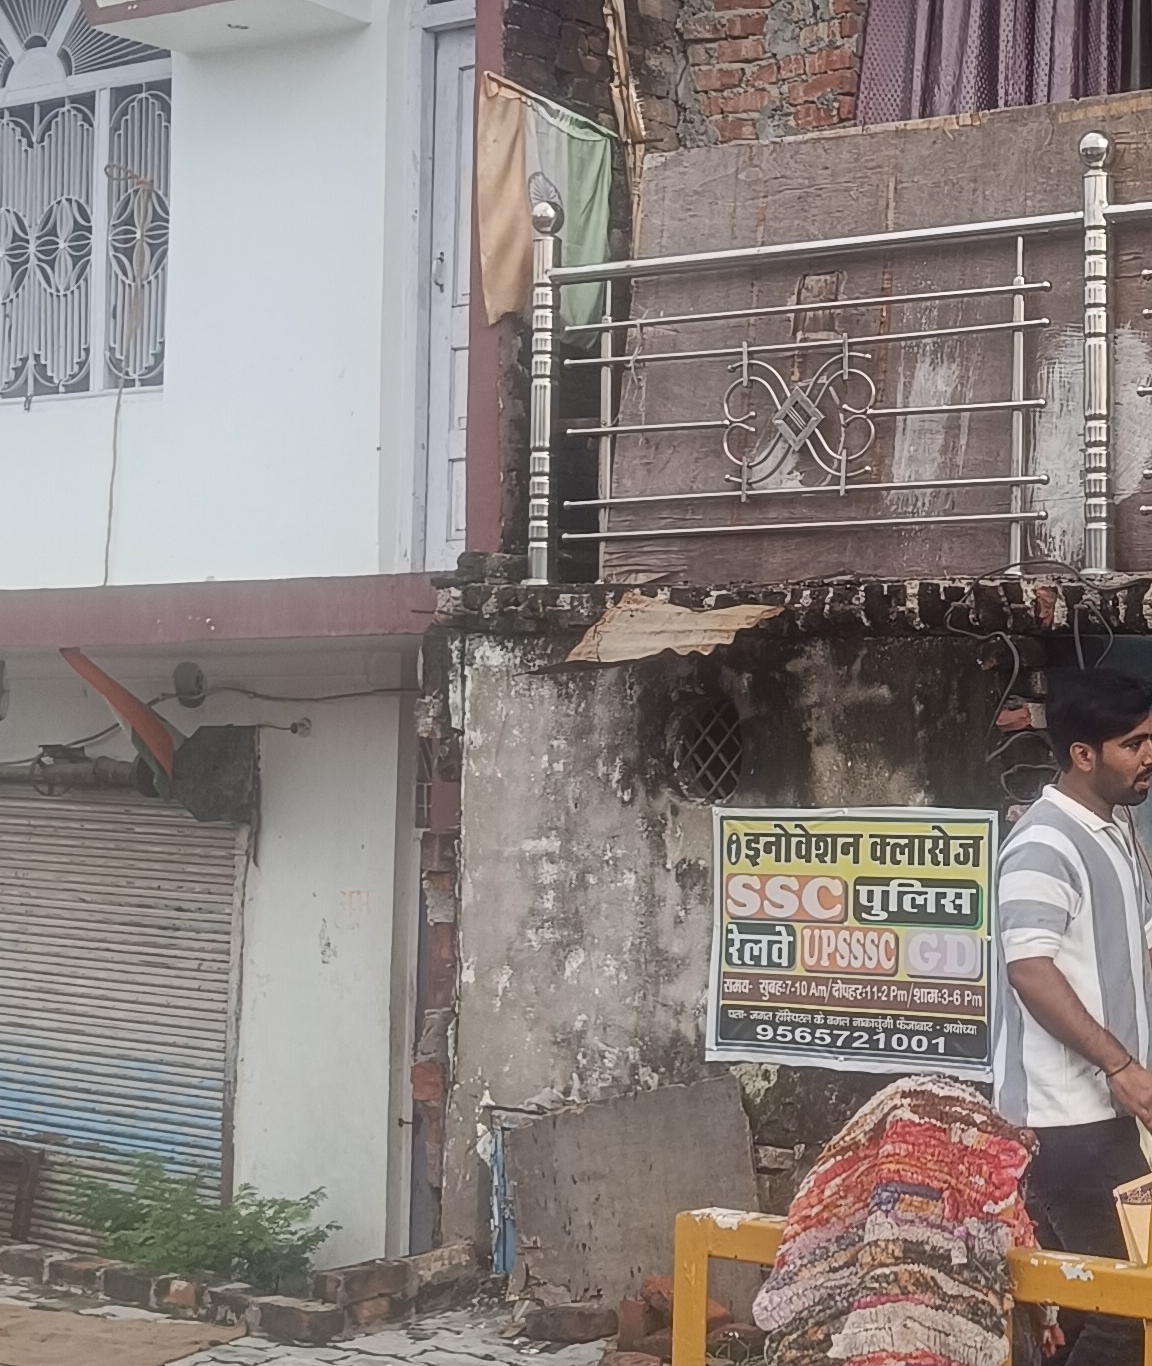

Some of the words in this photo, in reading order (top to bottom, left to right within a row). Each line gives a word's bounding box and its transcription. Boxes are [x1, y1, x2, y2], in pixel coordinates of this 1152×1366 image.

[744, 824, 863, 867] इनोवेशन
[869, 826, 984, 867] क्लासेज
[726, 875, 843, 919] SSC
[856, 879, 976, 920] पुलिस
[727, 924, 793, 967] रेलवे
[803, 928, 896, 970] UPSSSC
[908, 933, 977, 975] GD
[756, 1024, 945, 1053] 9565721001
[814, 1011, 825, 1024] के
[827, 1015, 850, 1027] बगल
